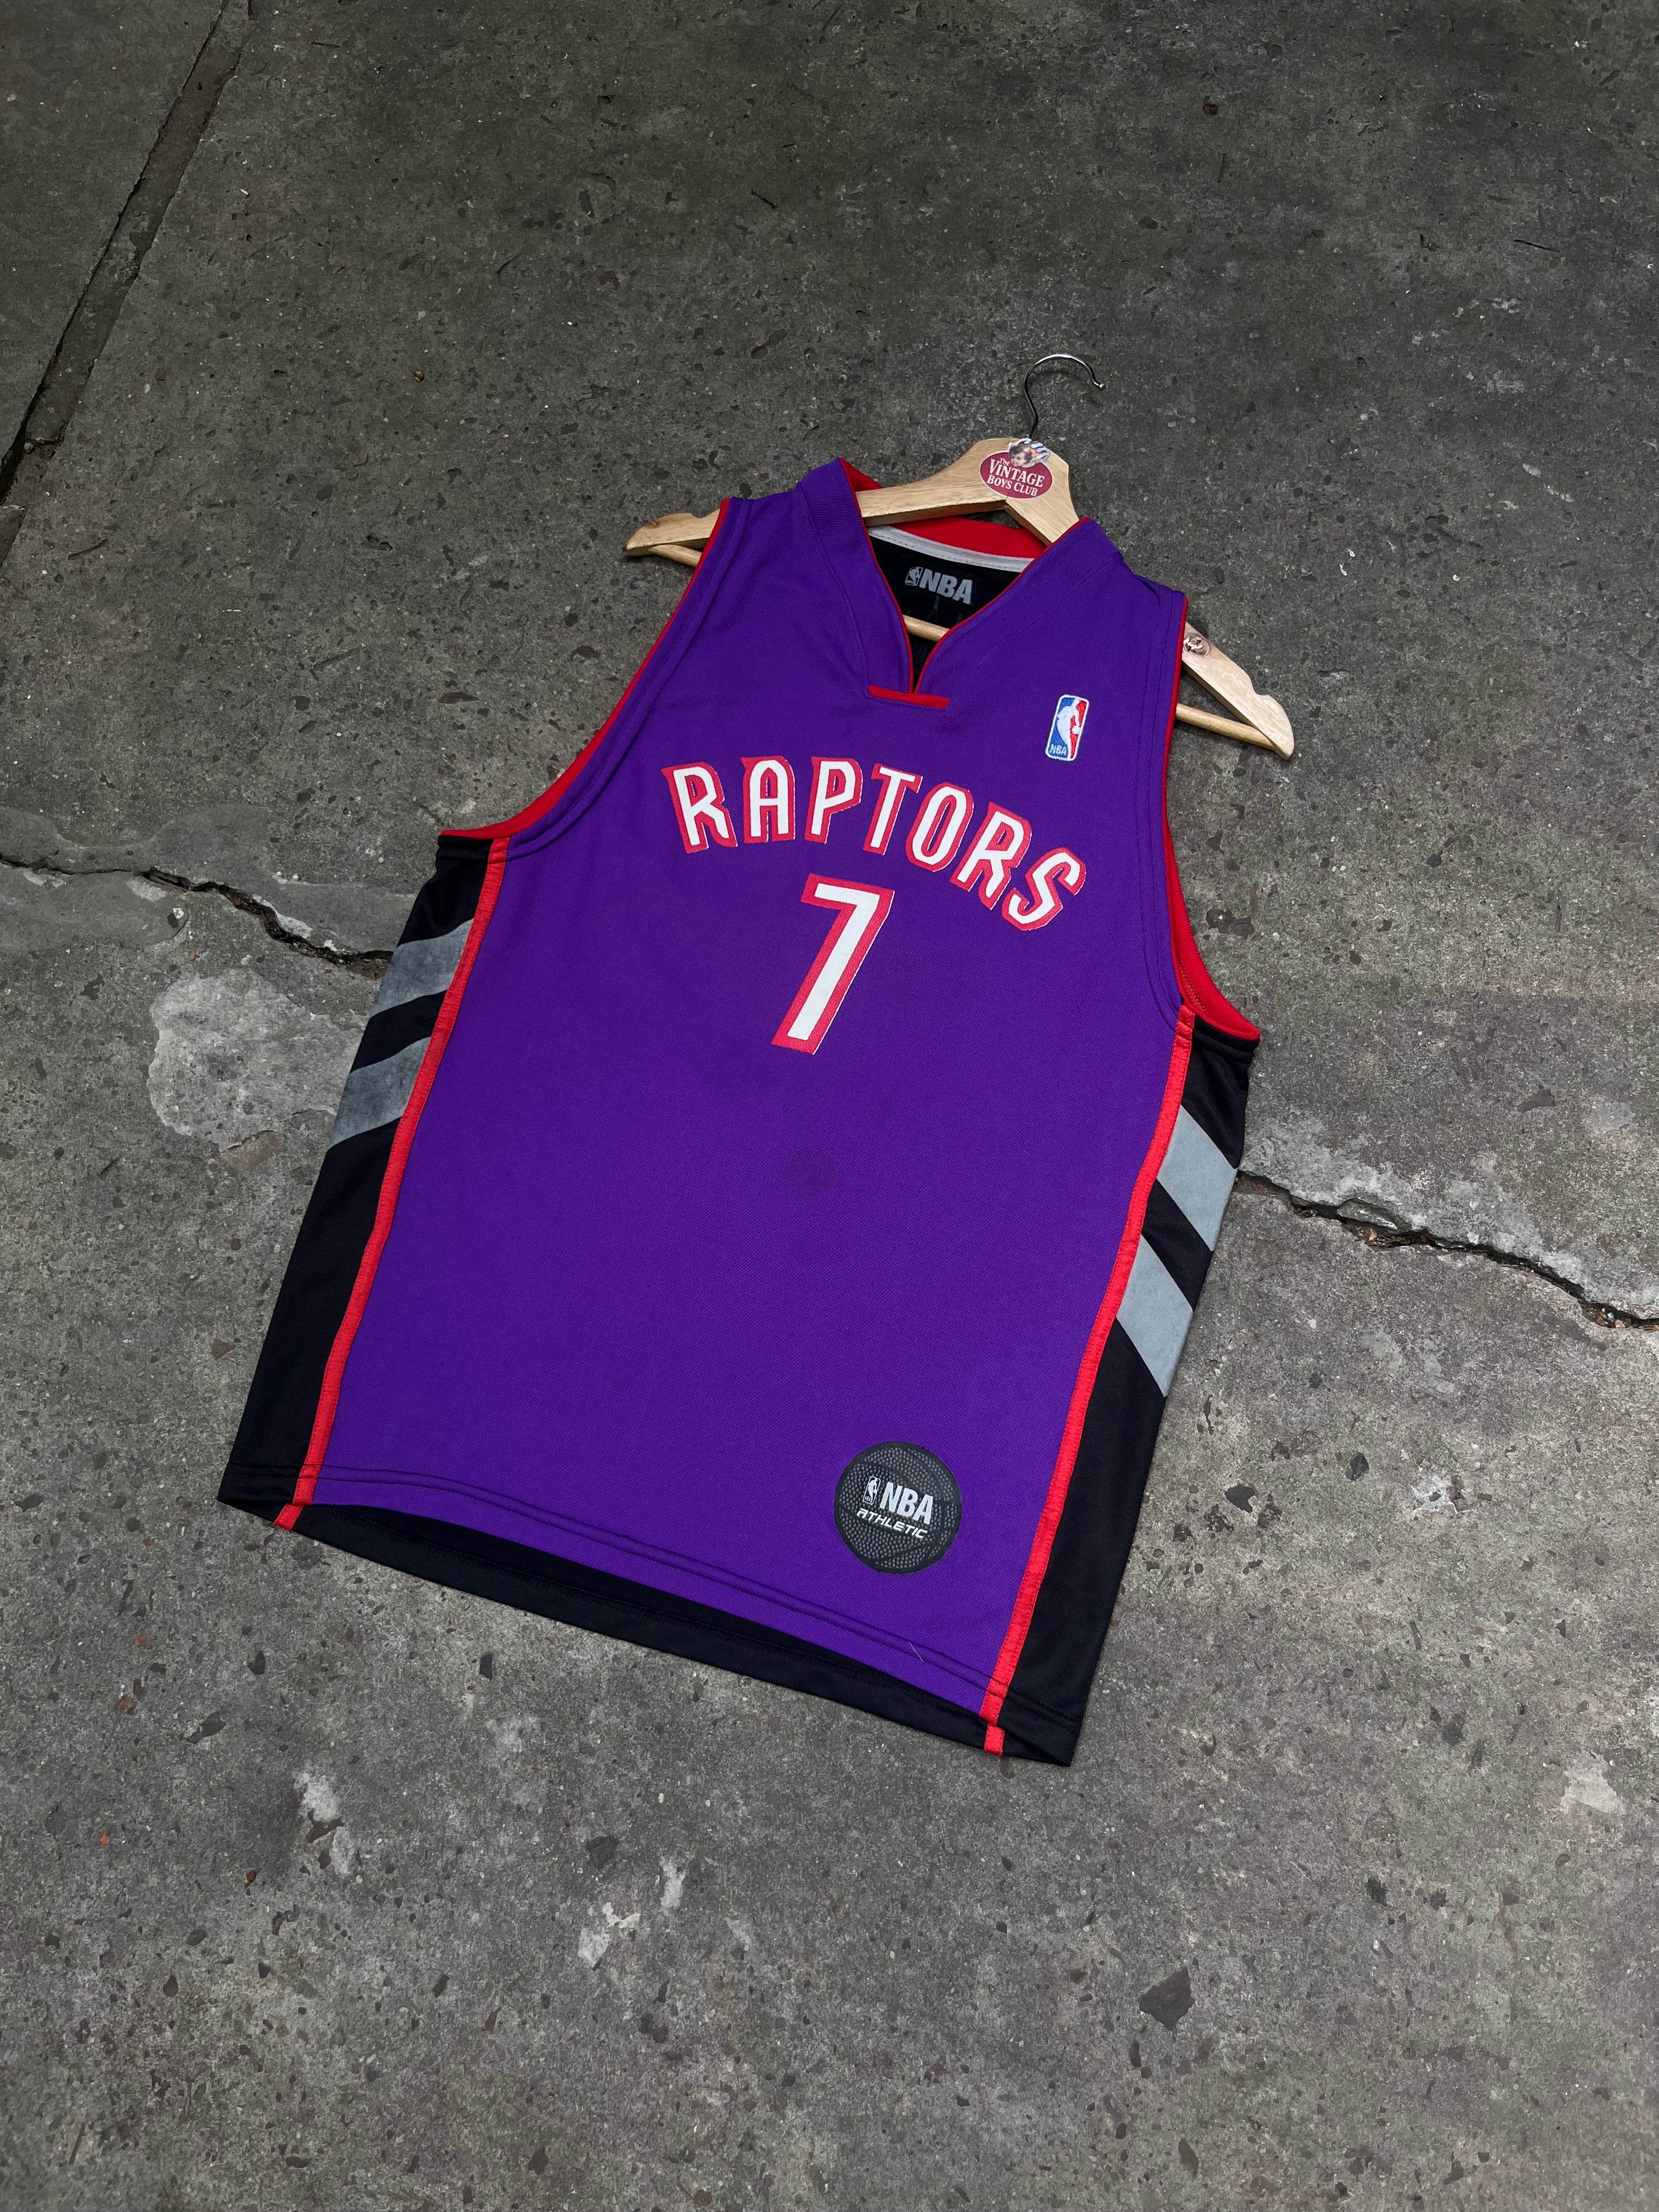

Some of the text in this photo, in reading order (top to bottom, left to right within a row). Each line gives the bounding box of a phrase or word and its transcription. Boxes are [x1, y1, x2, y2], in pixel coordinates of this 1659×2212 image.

[989, 459, 1045, 487] VINTAGE
[1000, 458, 1010, 466] The
[987, 474, 1038, 496] BOYS CLUB
[919, 568, 973, 605] NBA
[1049, 744, 1066, 755] NBA
[661, 755, 1086, 931] RAPTORS
[771, 873, 895, 1054] 7
[879, 1482, 933, 1525] NBA
[856, 1508, 928, 1538] ATHLETIC
